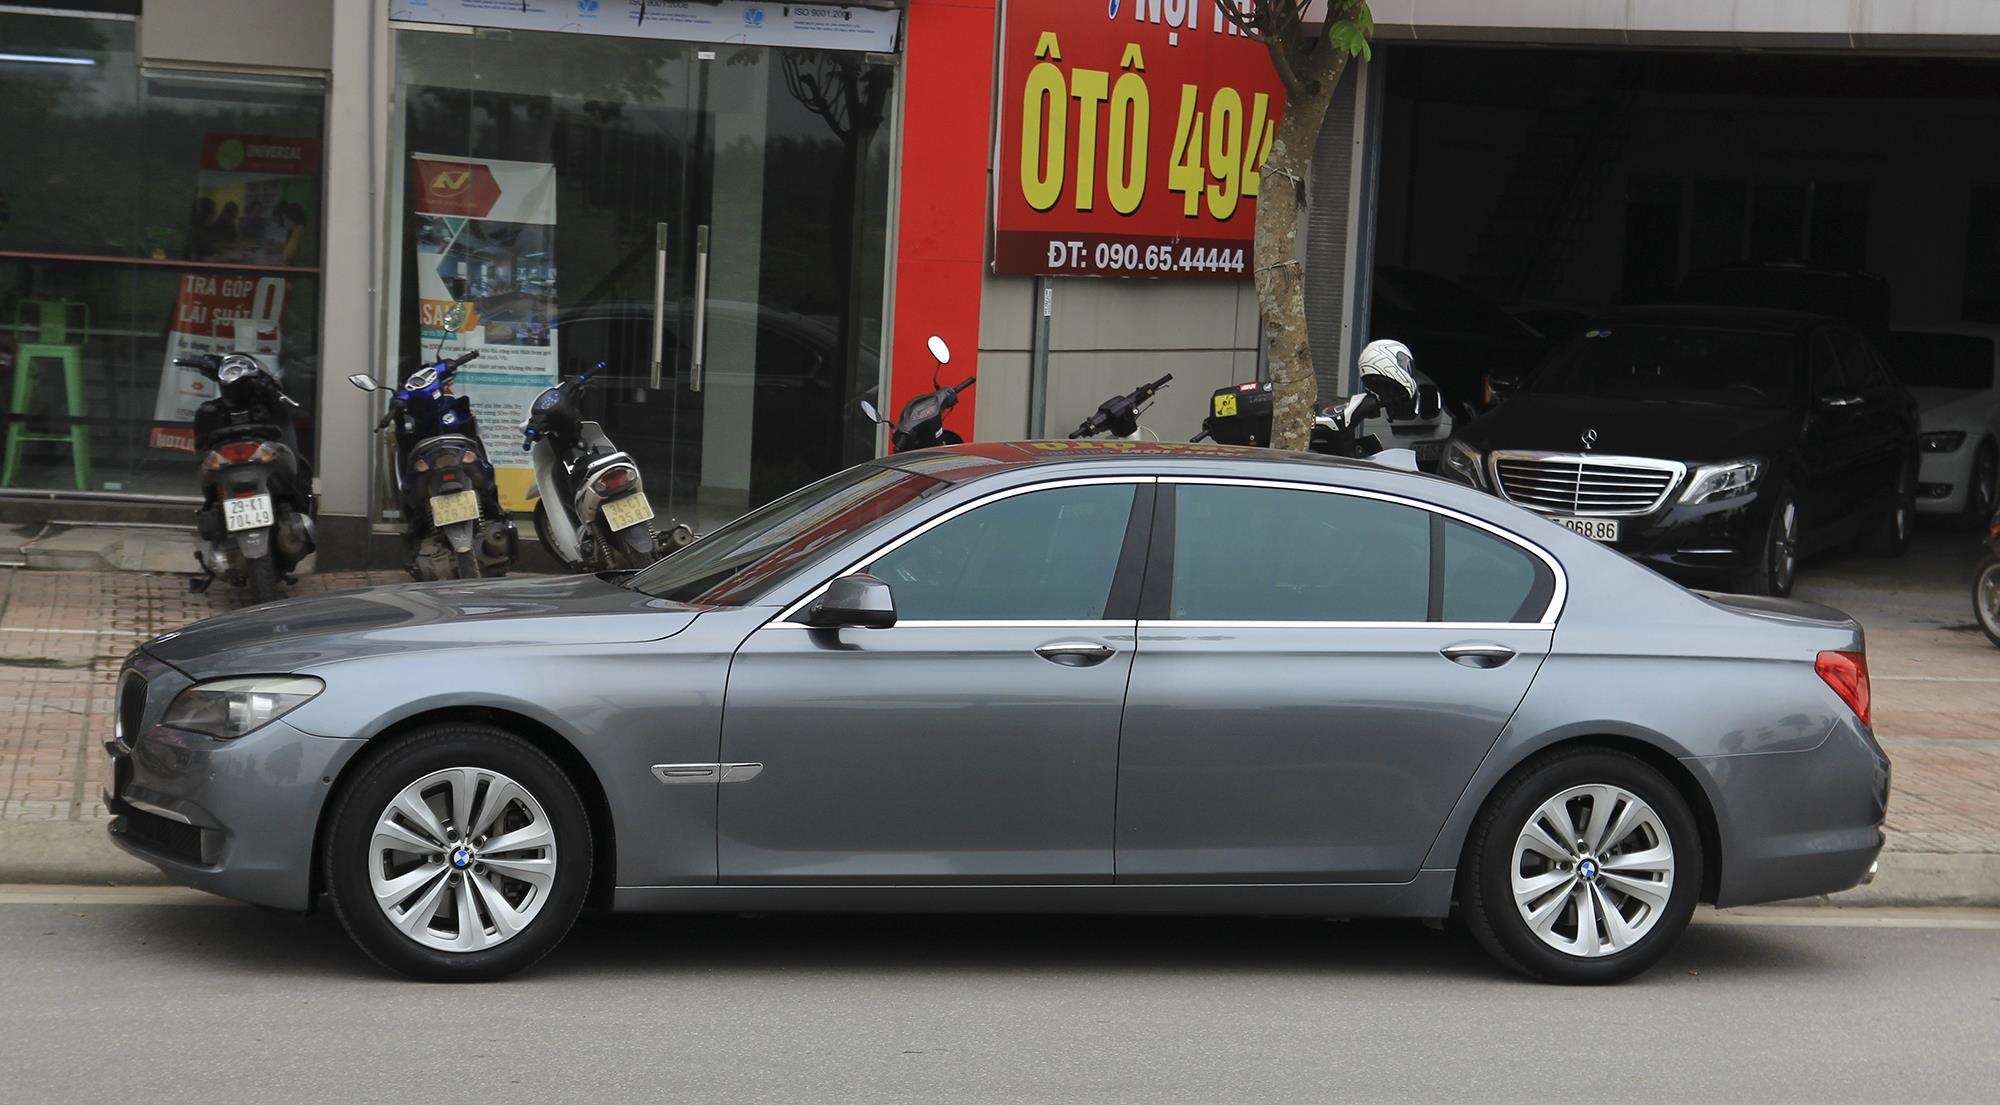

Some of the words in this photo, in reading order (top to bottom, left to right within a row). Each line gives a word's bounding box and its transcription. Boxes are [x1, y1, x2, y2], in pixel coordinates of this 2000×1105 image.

[1020, 31, 1150, 214] ÔTÔ
[1168, 84, 1274, 220] 494
[1048, 241, 1088, 268] ĐT:
[1095, 243, 1245, 273] 090.65.44444
[222, 276, 254, 298] GÓP
